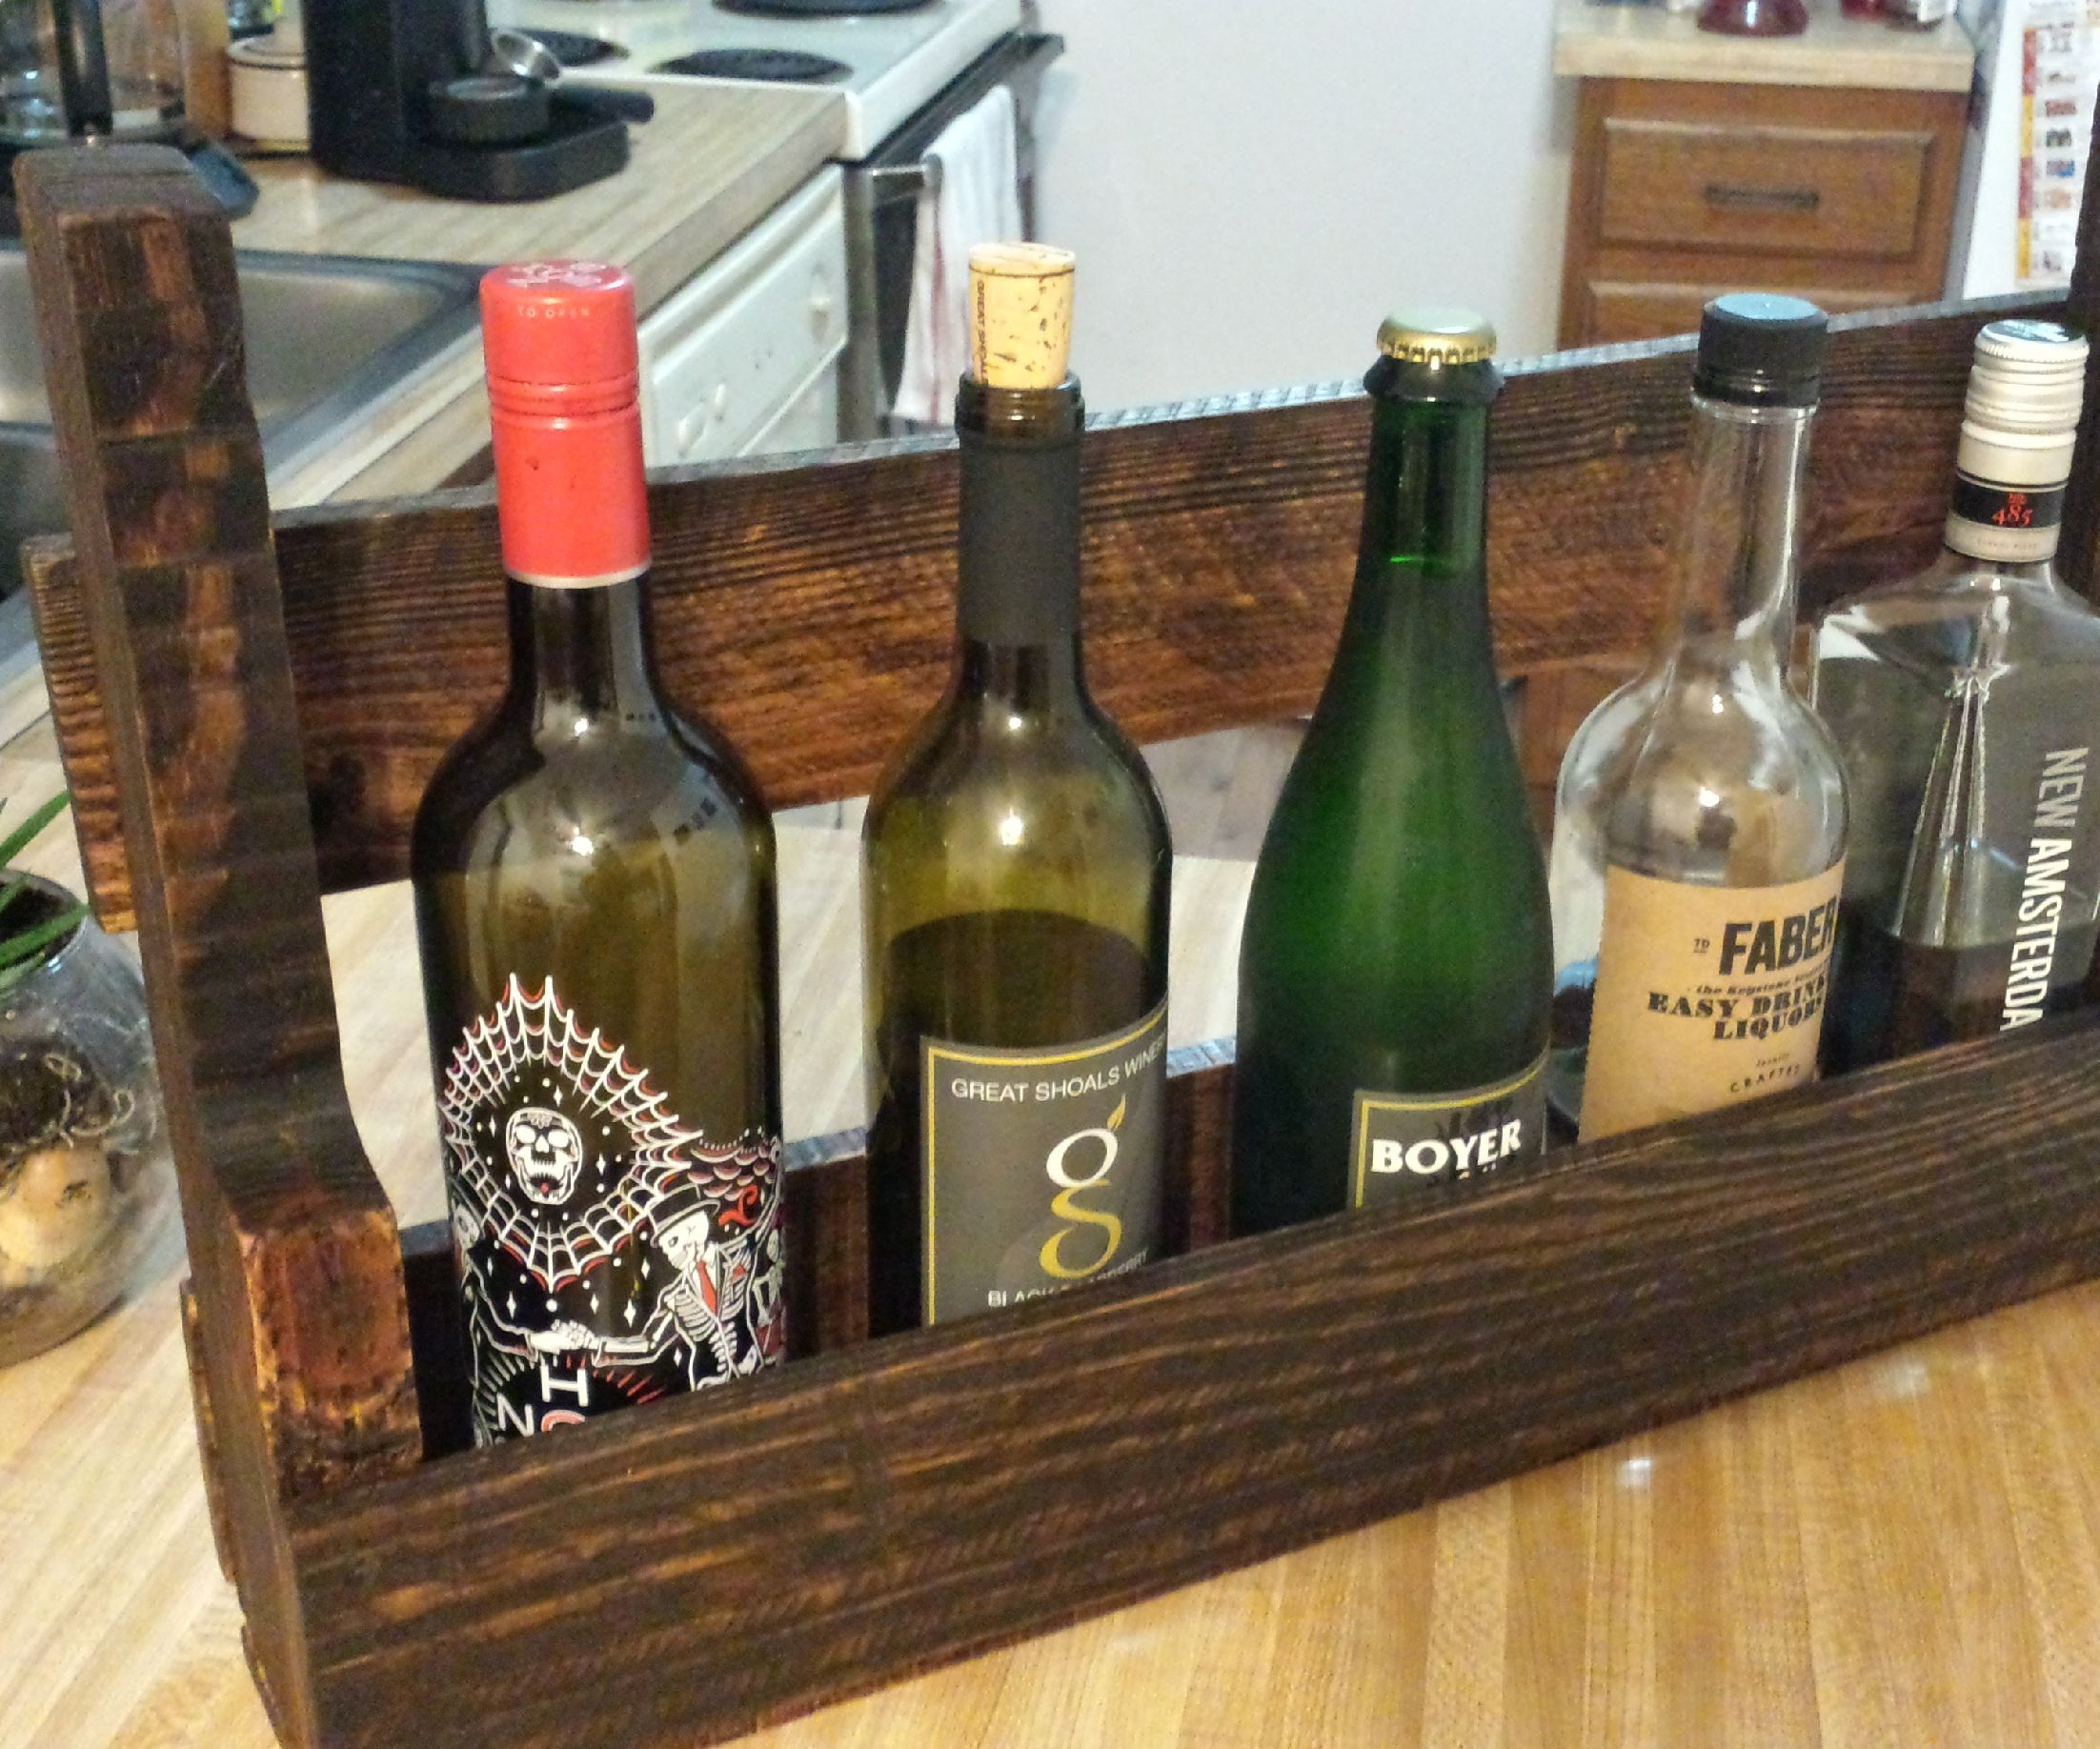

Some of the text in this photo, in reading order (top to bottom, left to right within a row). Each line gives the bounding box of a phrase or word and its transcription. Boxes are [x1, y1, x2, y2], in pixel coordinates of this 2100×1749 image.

[1991, 505, 2033, 528] 485
[2033, 747, 2090, 828] NEW
[1719, 895, 1837, 975] FABER
[1648, 992, 1738, 1018] EASY
[951, 1077, 1030, 1103] GREAT
[1035, 1066, 1121, 1103] SHOALS
[1370, 1118, 1522, 1174] BOYER
